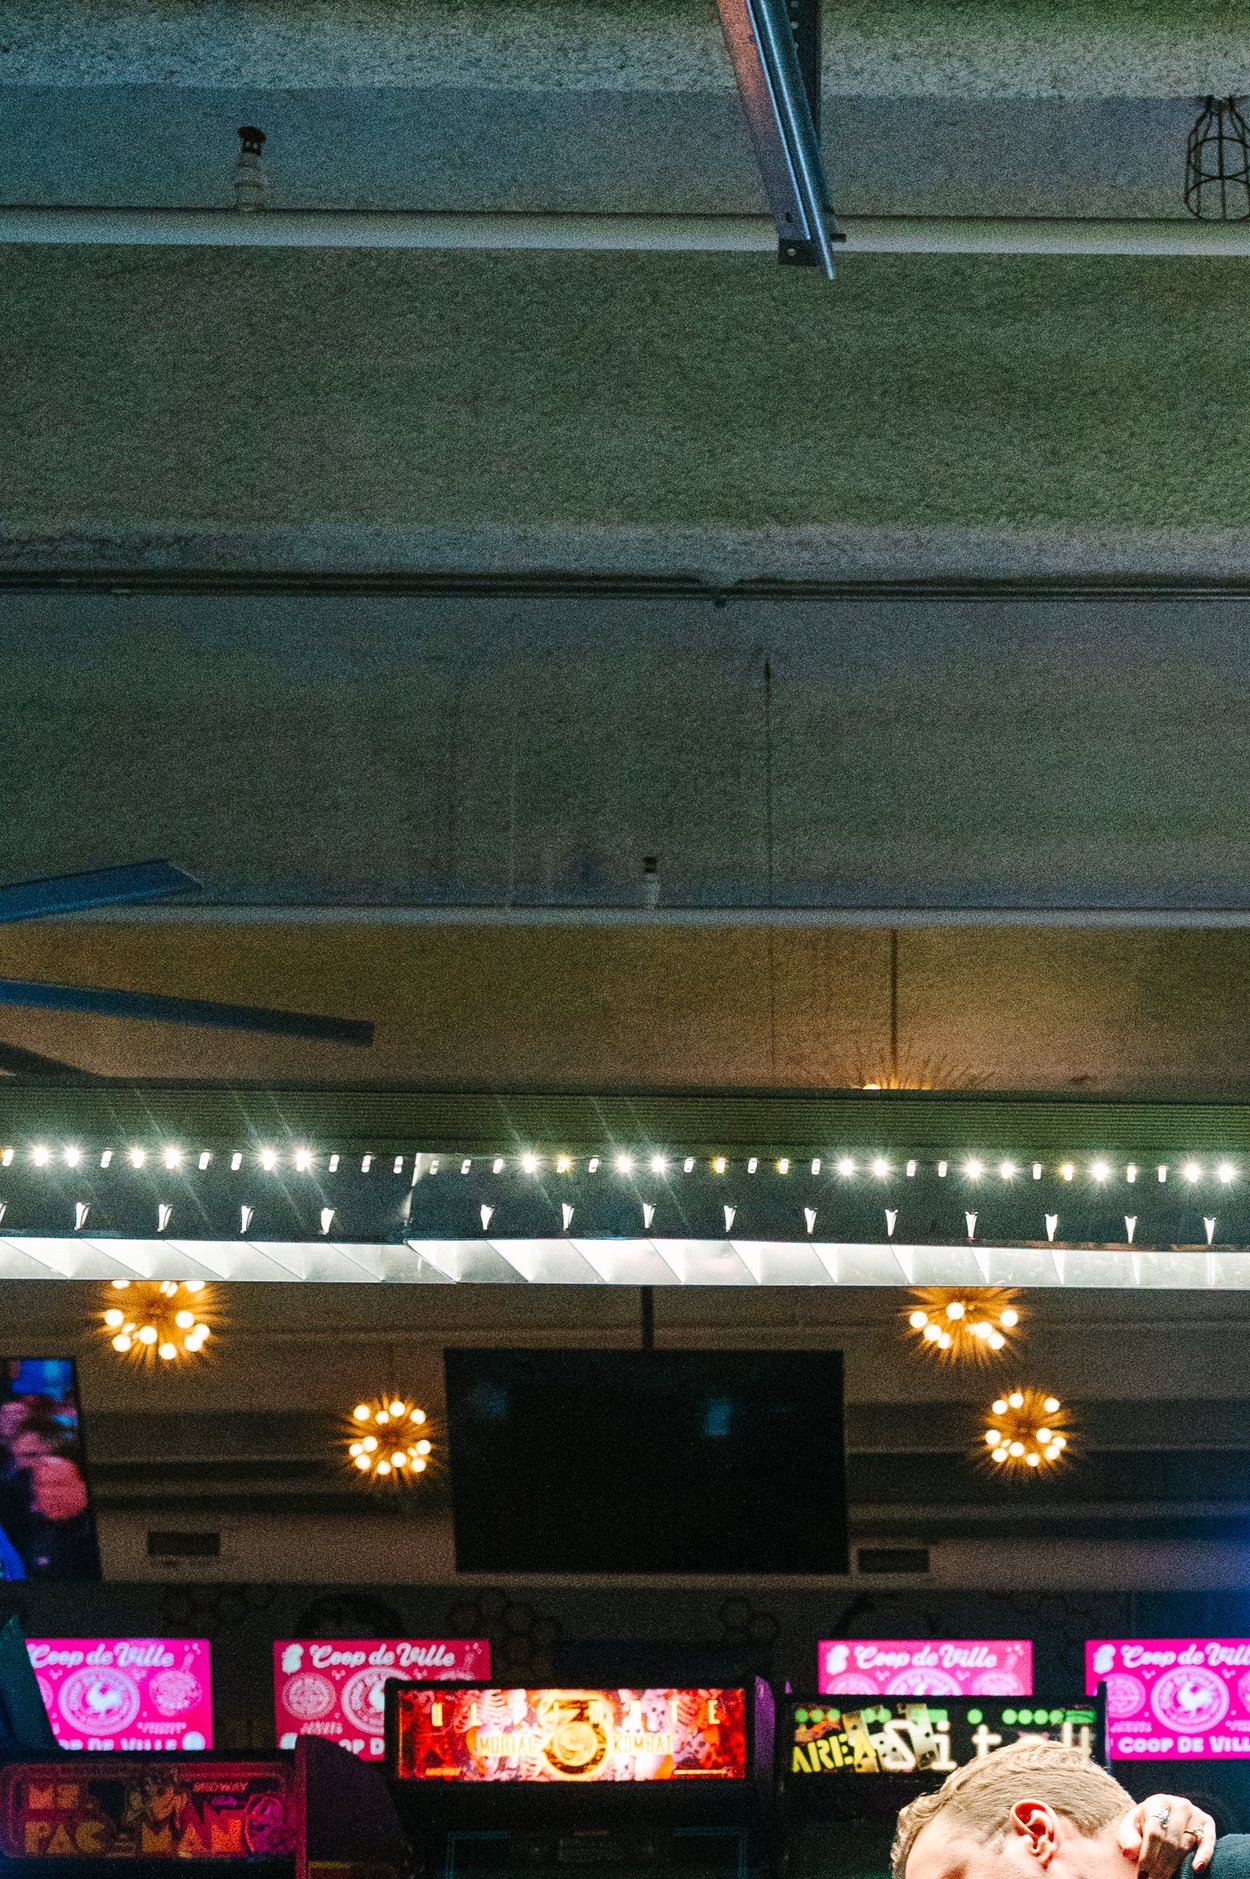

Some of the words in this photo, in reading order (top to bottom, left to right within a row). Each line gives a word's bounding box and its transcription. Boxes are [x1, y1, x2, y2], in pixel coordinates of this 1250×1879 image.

[113, 1641, 175, 1668] Ville
[309, 1644, 366, 1669] Coop
[368, 1643, 395, 1666] de
[396, 1642, 456, 1667] Ville
[853, 1645, 910, 1669] Coop
[911, 1645, 939, 1667] de
[938, 1644, 998, 1668] Ville
[1120, 1644, 1176, 1668] Coop
[1177, 1643, 1205, 1665] de
[1117, 1736, 1174, 1754] COOP
[1177, 1736, 1205, 1754] DE
